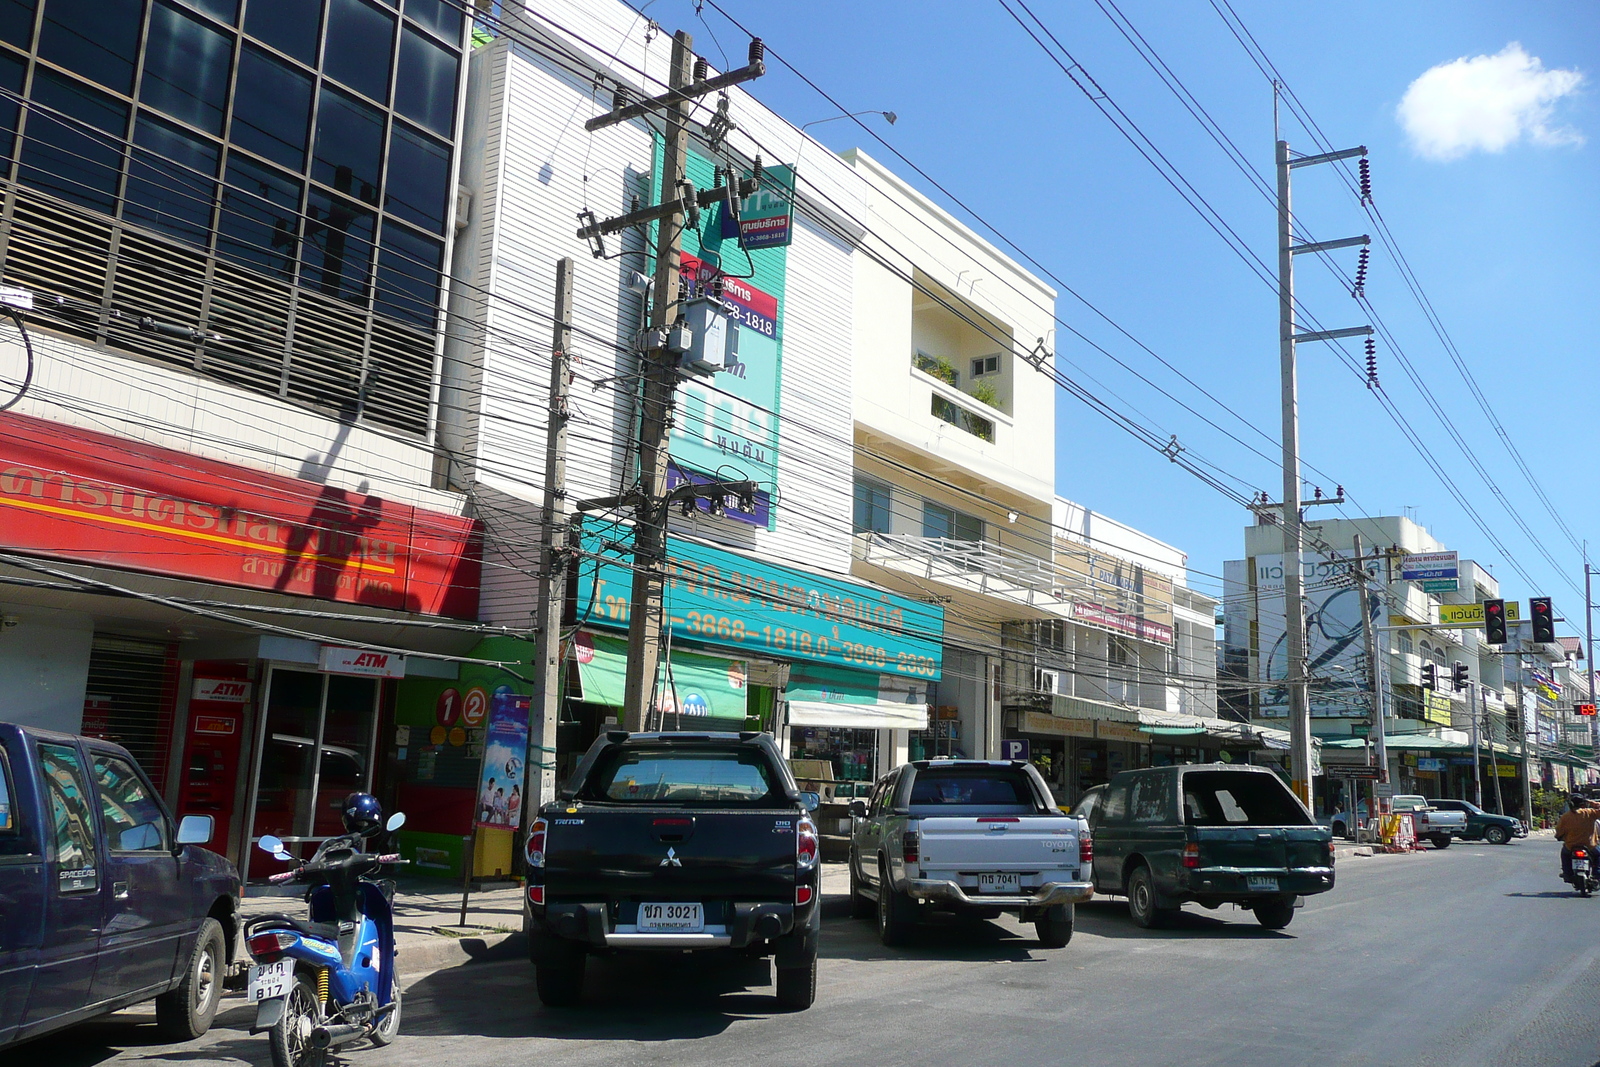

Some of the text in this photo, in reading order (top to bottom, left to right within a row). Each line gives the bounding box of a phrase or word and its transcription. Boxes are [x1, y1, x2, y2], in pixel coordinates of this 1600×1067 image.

[742, 218, 786, 234] ศูนย์บริการ
[353, 652, 389, 669] ATM
[211, 682, 247, 697] ATM
[1009, 741, 1023, 759] P
[1041, 840, 1074, 848] TOYOTA
[73, 879, 85, 888] SL
[997, 874, 1017, 884] 7041
[667, 905, 698, 919] 3021
[256, 984, 283, 999] 817
